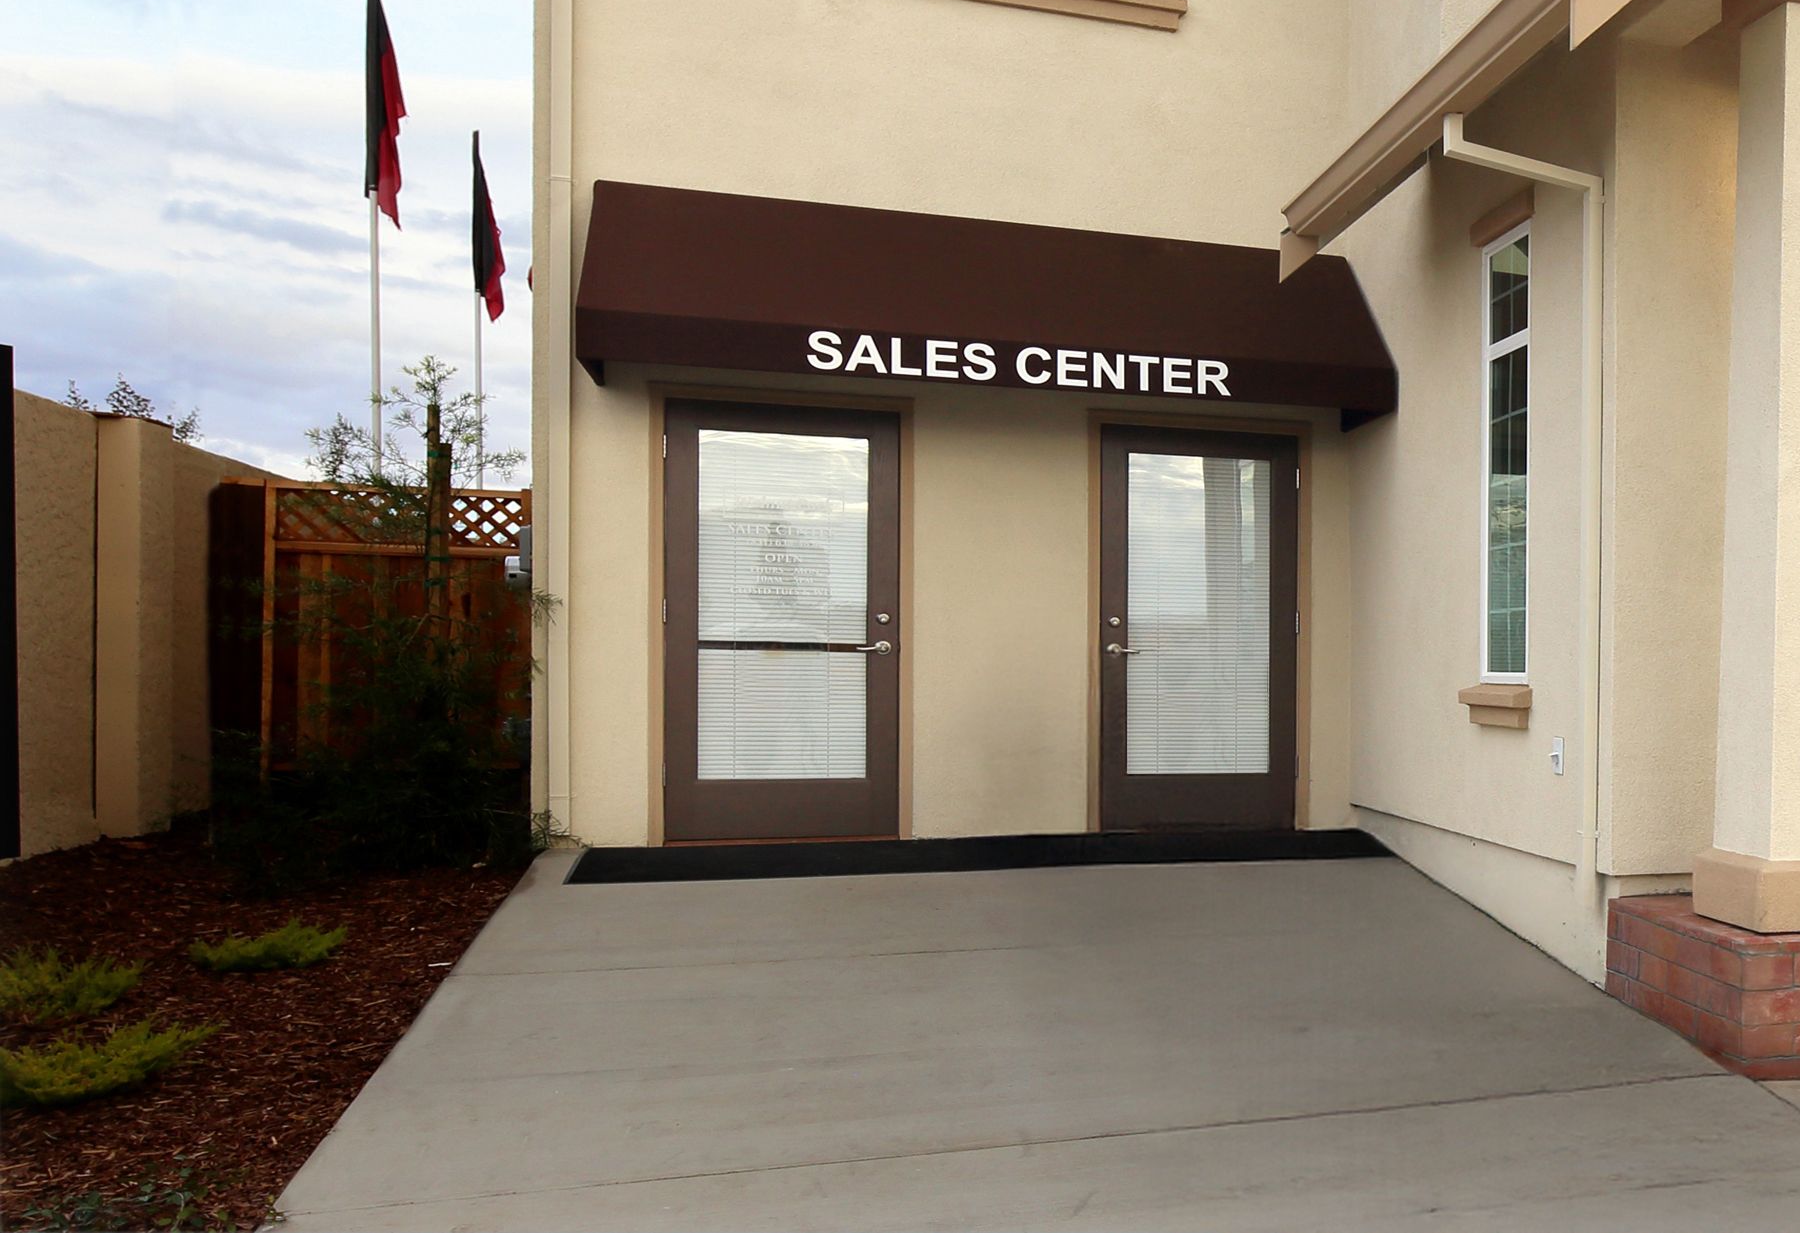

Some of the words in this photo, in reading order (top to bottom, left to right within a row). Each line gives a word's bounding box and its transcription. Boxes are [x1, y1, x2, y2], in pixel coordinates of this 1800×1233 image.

[807, 330, 997, 381] SALES
[1016, 346, 1231, 396] CENTER
[764, 553, 801, 563] OPEN
